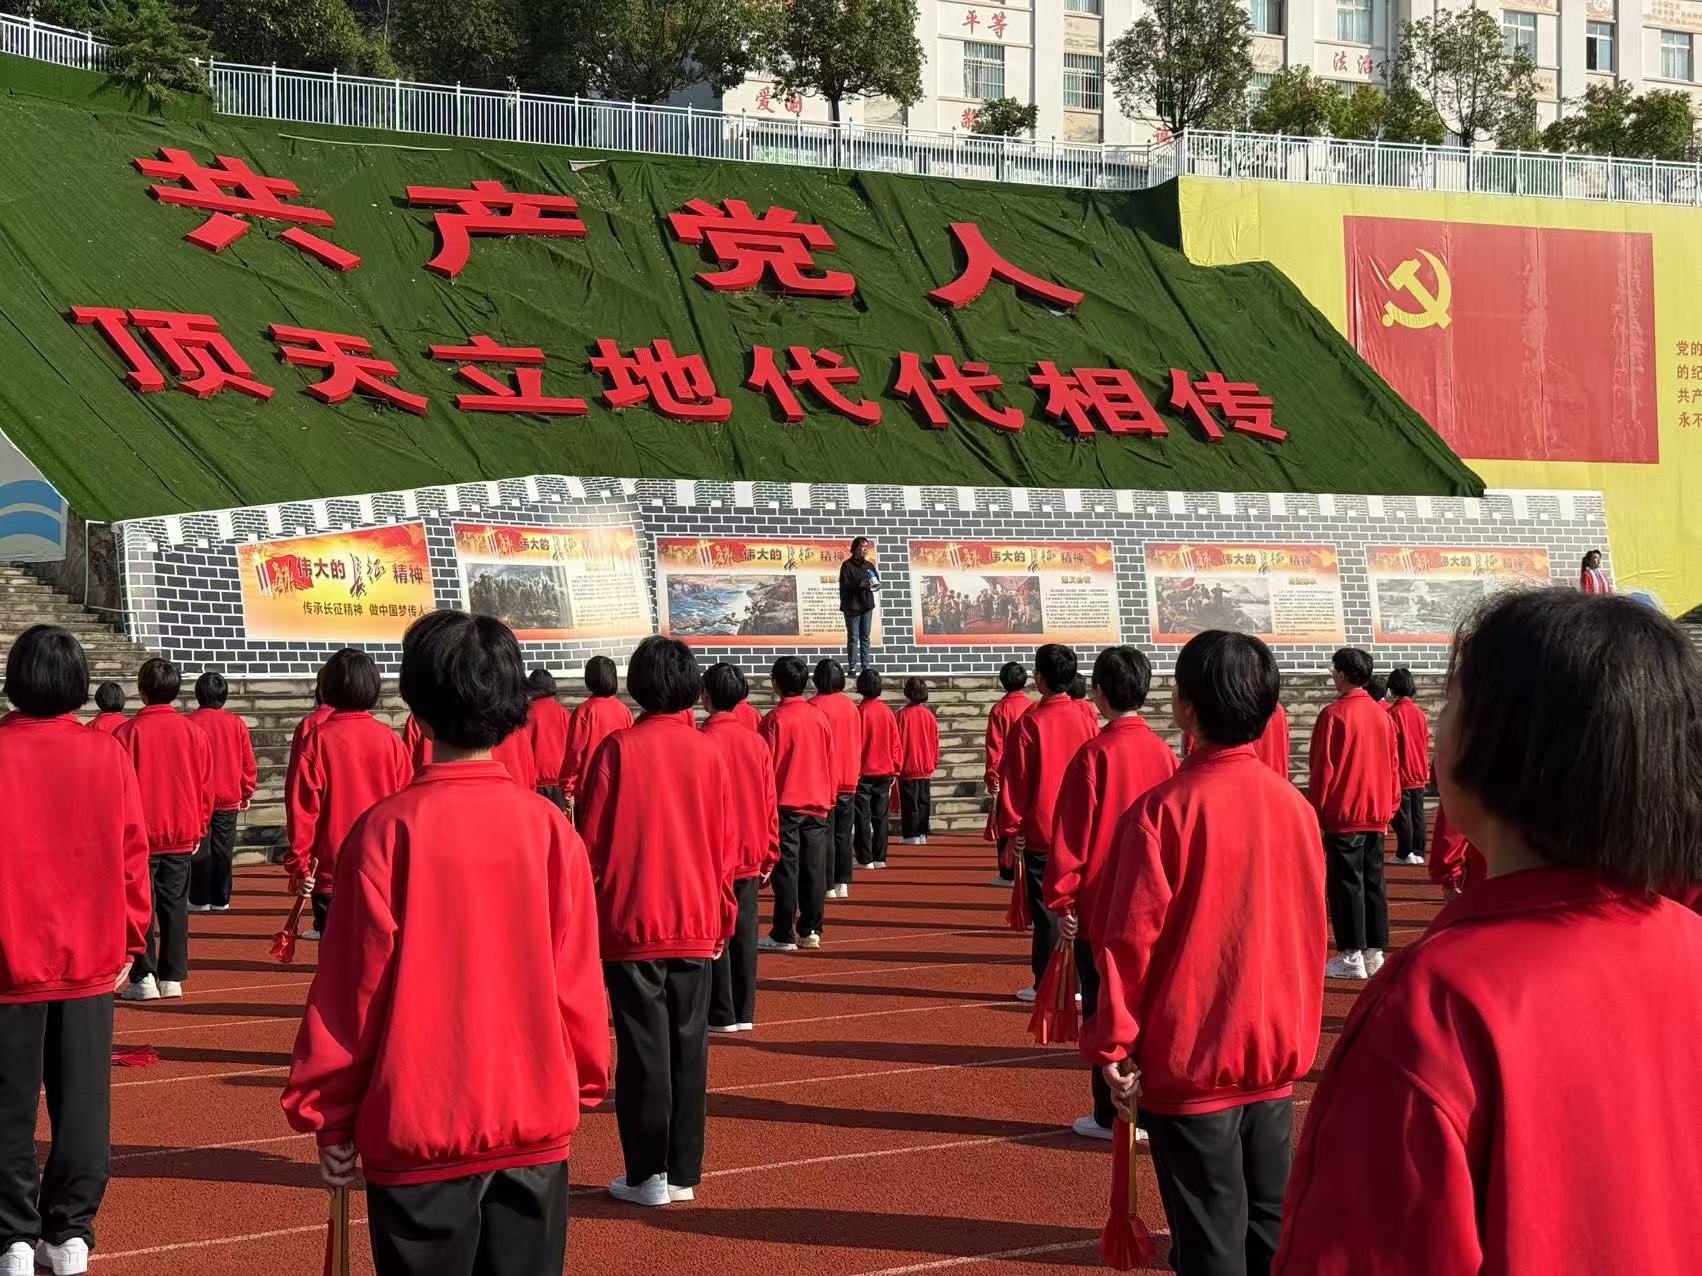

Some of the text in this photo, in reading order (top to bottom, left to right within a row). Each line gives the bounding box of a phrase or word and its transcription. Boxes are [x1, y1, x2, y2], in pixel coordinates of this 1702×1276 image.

[962, 9, 1008, 39] 平等
[1332, 50, 1374, 75] 法治
[133, 146, 1085, 310] 共产党人
[70, 305, 1290, 444] 顶天立地代代相传
[302, 600, 426, 618] 传承长征精神 做中国梦传人
